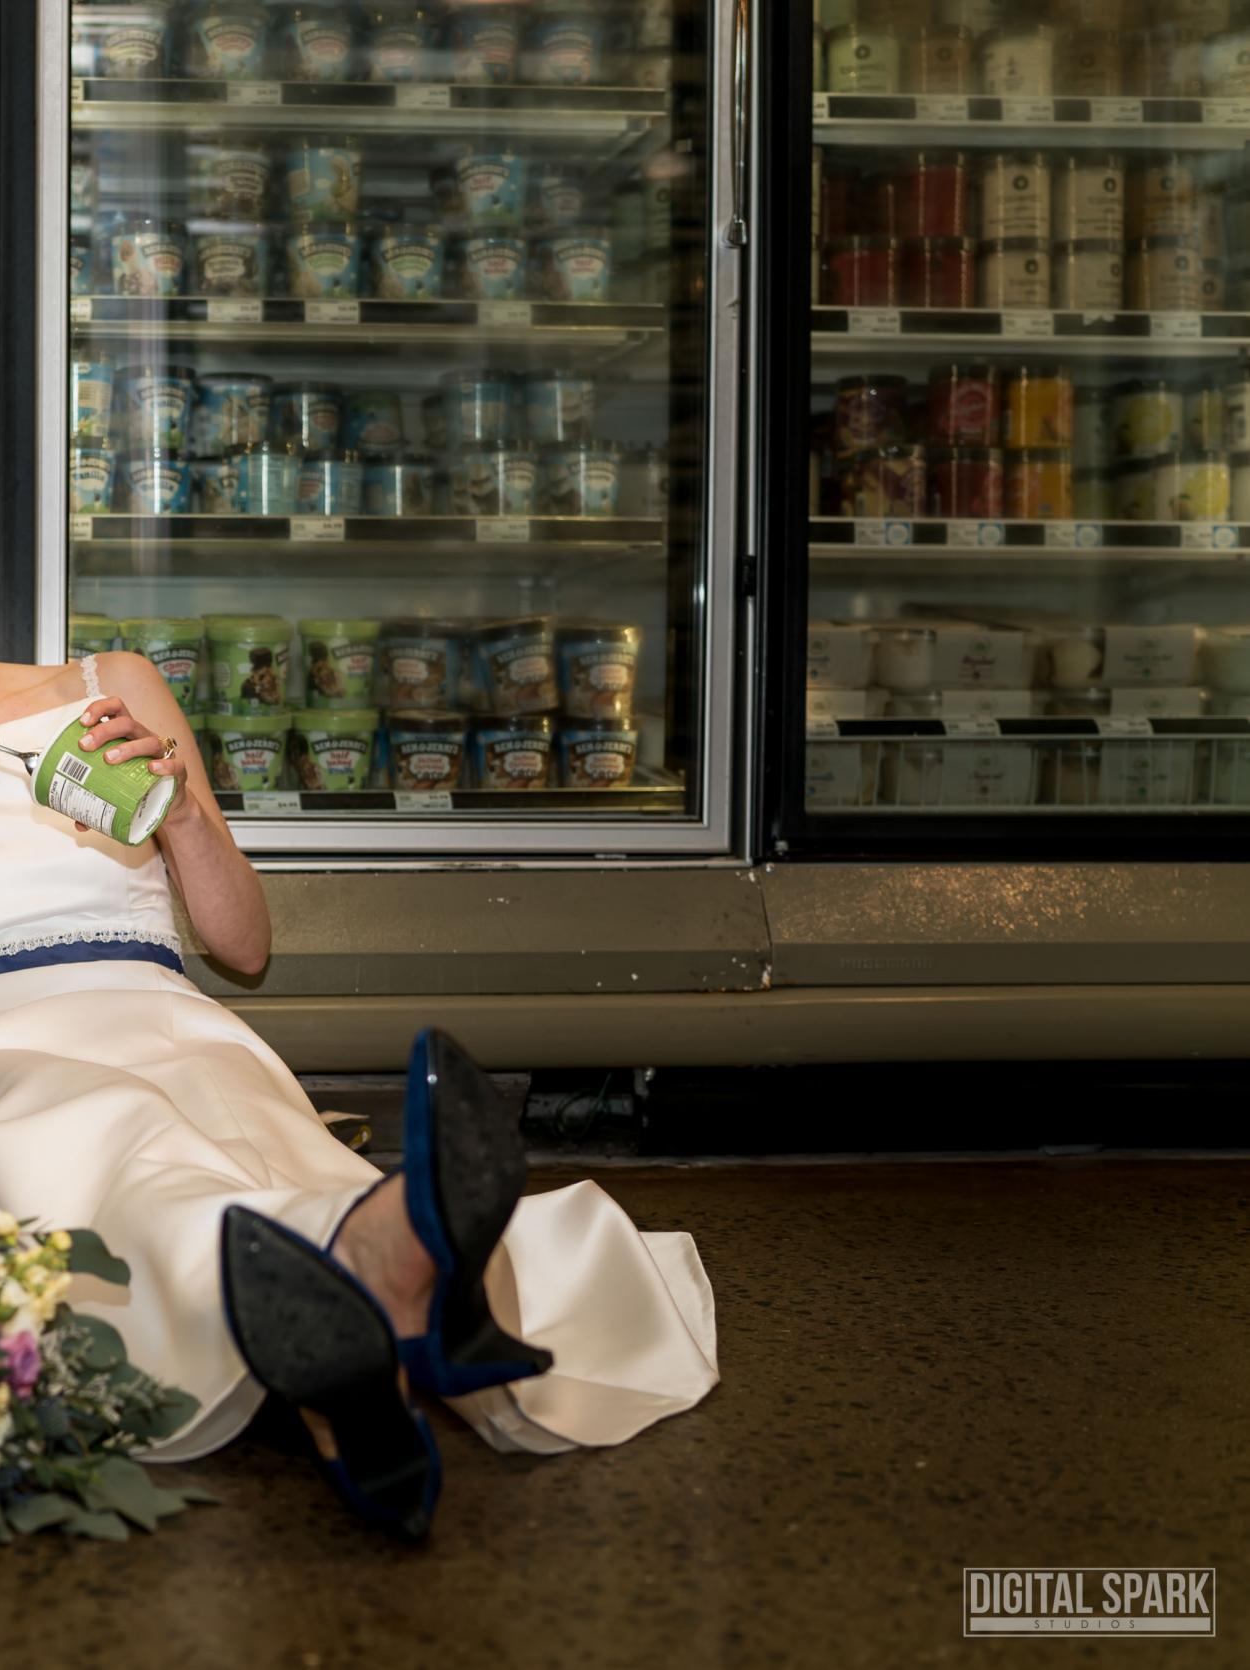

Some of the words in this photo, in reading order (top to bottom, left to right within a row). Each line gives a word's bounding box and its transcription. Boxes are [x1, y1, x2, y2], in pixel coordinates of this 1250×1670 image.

[228, 740, 244, 751] BEN
[314, 740, 331, 752] BEN
[401, 743, 420, 753] BEN
[244, 751, 264, 759] half
[329, 751, 350, 759] half
[240, 759, 267, 767] baked
[326, 759, 352, 767] baked
